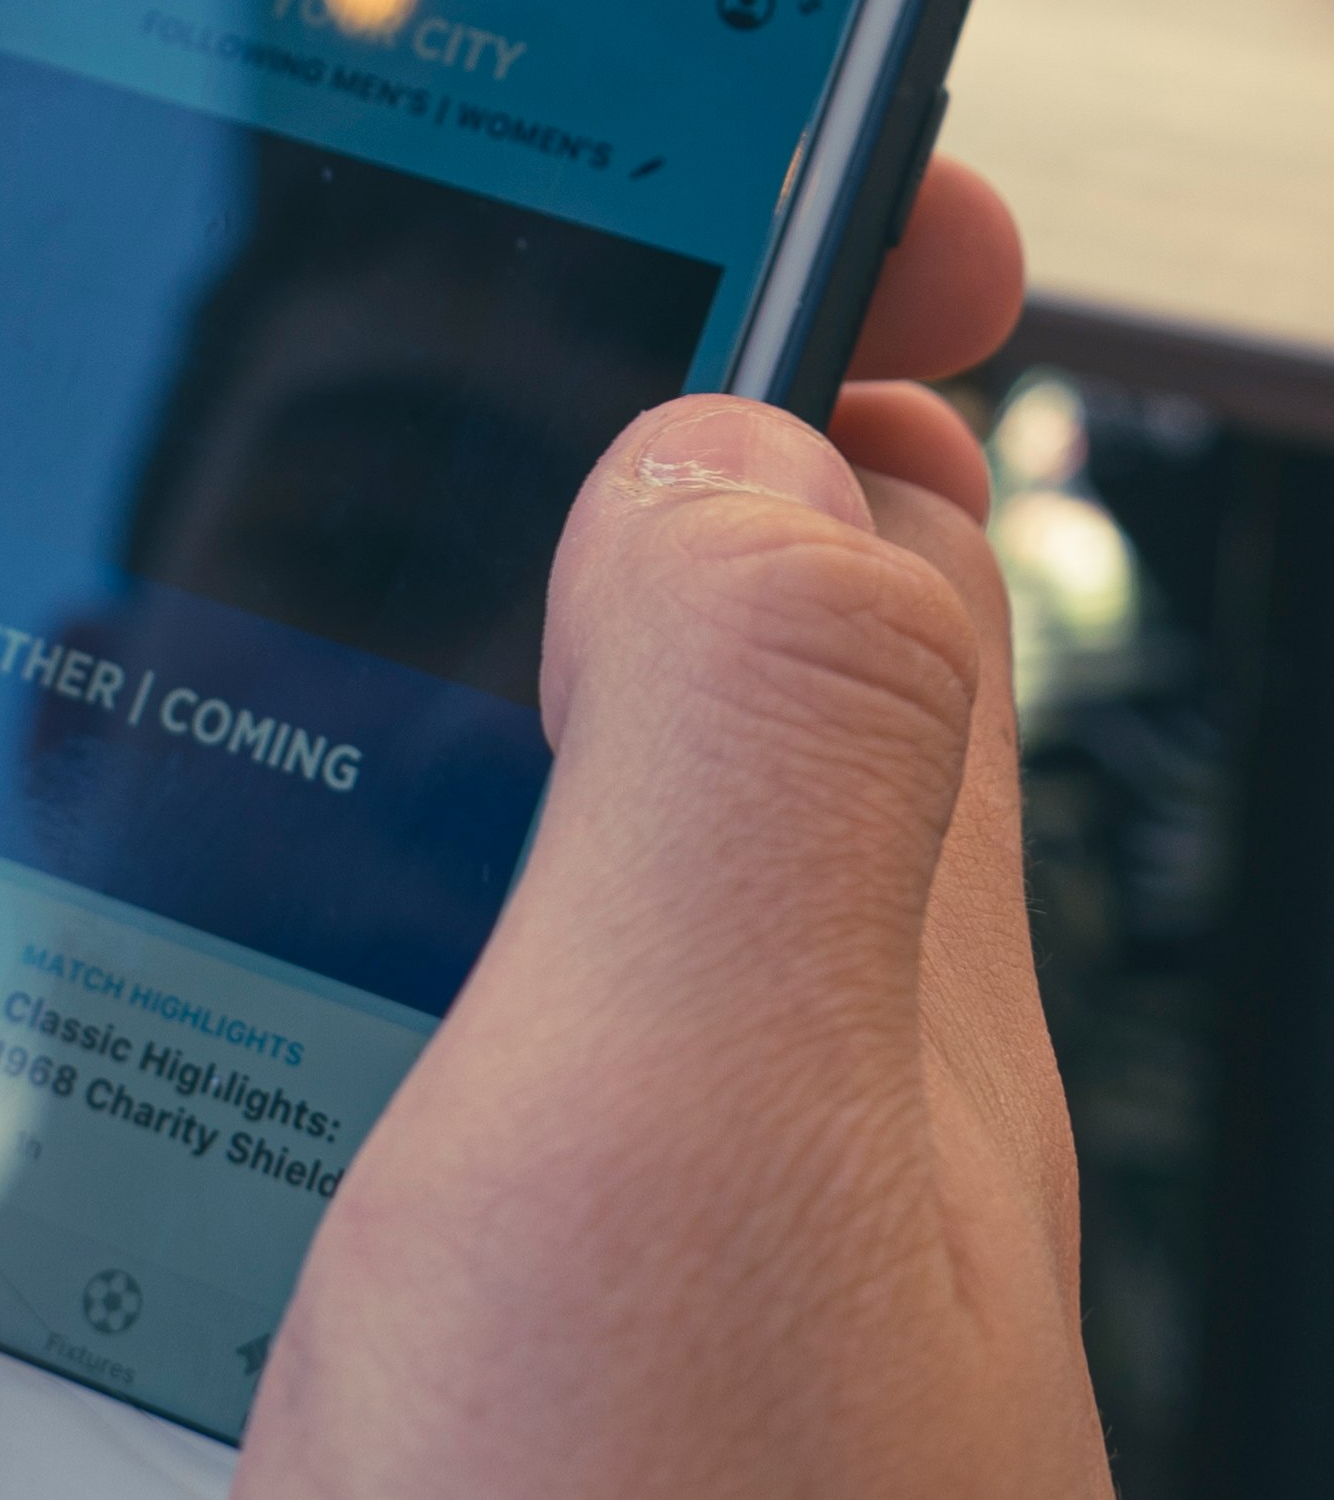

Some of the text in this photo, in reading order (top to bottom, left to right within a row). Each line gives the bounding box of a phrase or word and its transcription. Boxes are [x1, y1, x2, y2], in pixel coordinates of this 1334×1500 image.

[413, 18, 527, 80] CITY
[329, 65, 430, 118] MEN'S
[456, 101, 613, 170] WOMEN'S
[160, 687, 363, 792] COMING
[22, 944, 306, 1067] MATCH HIGHLIGHTS
[4, 991, 341, 1144] Classic Highlights:
[86, 1078, 220, 1156] Charity
[45, 1331, 137, 1385] Fixtures
